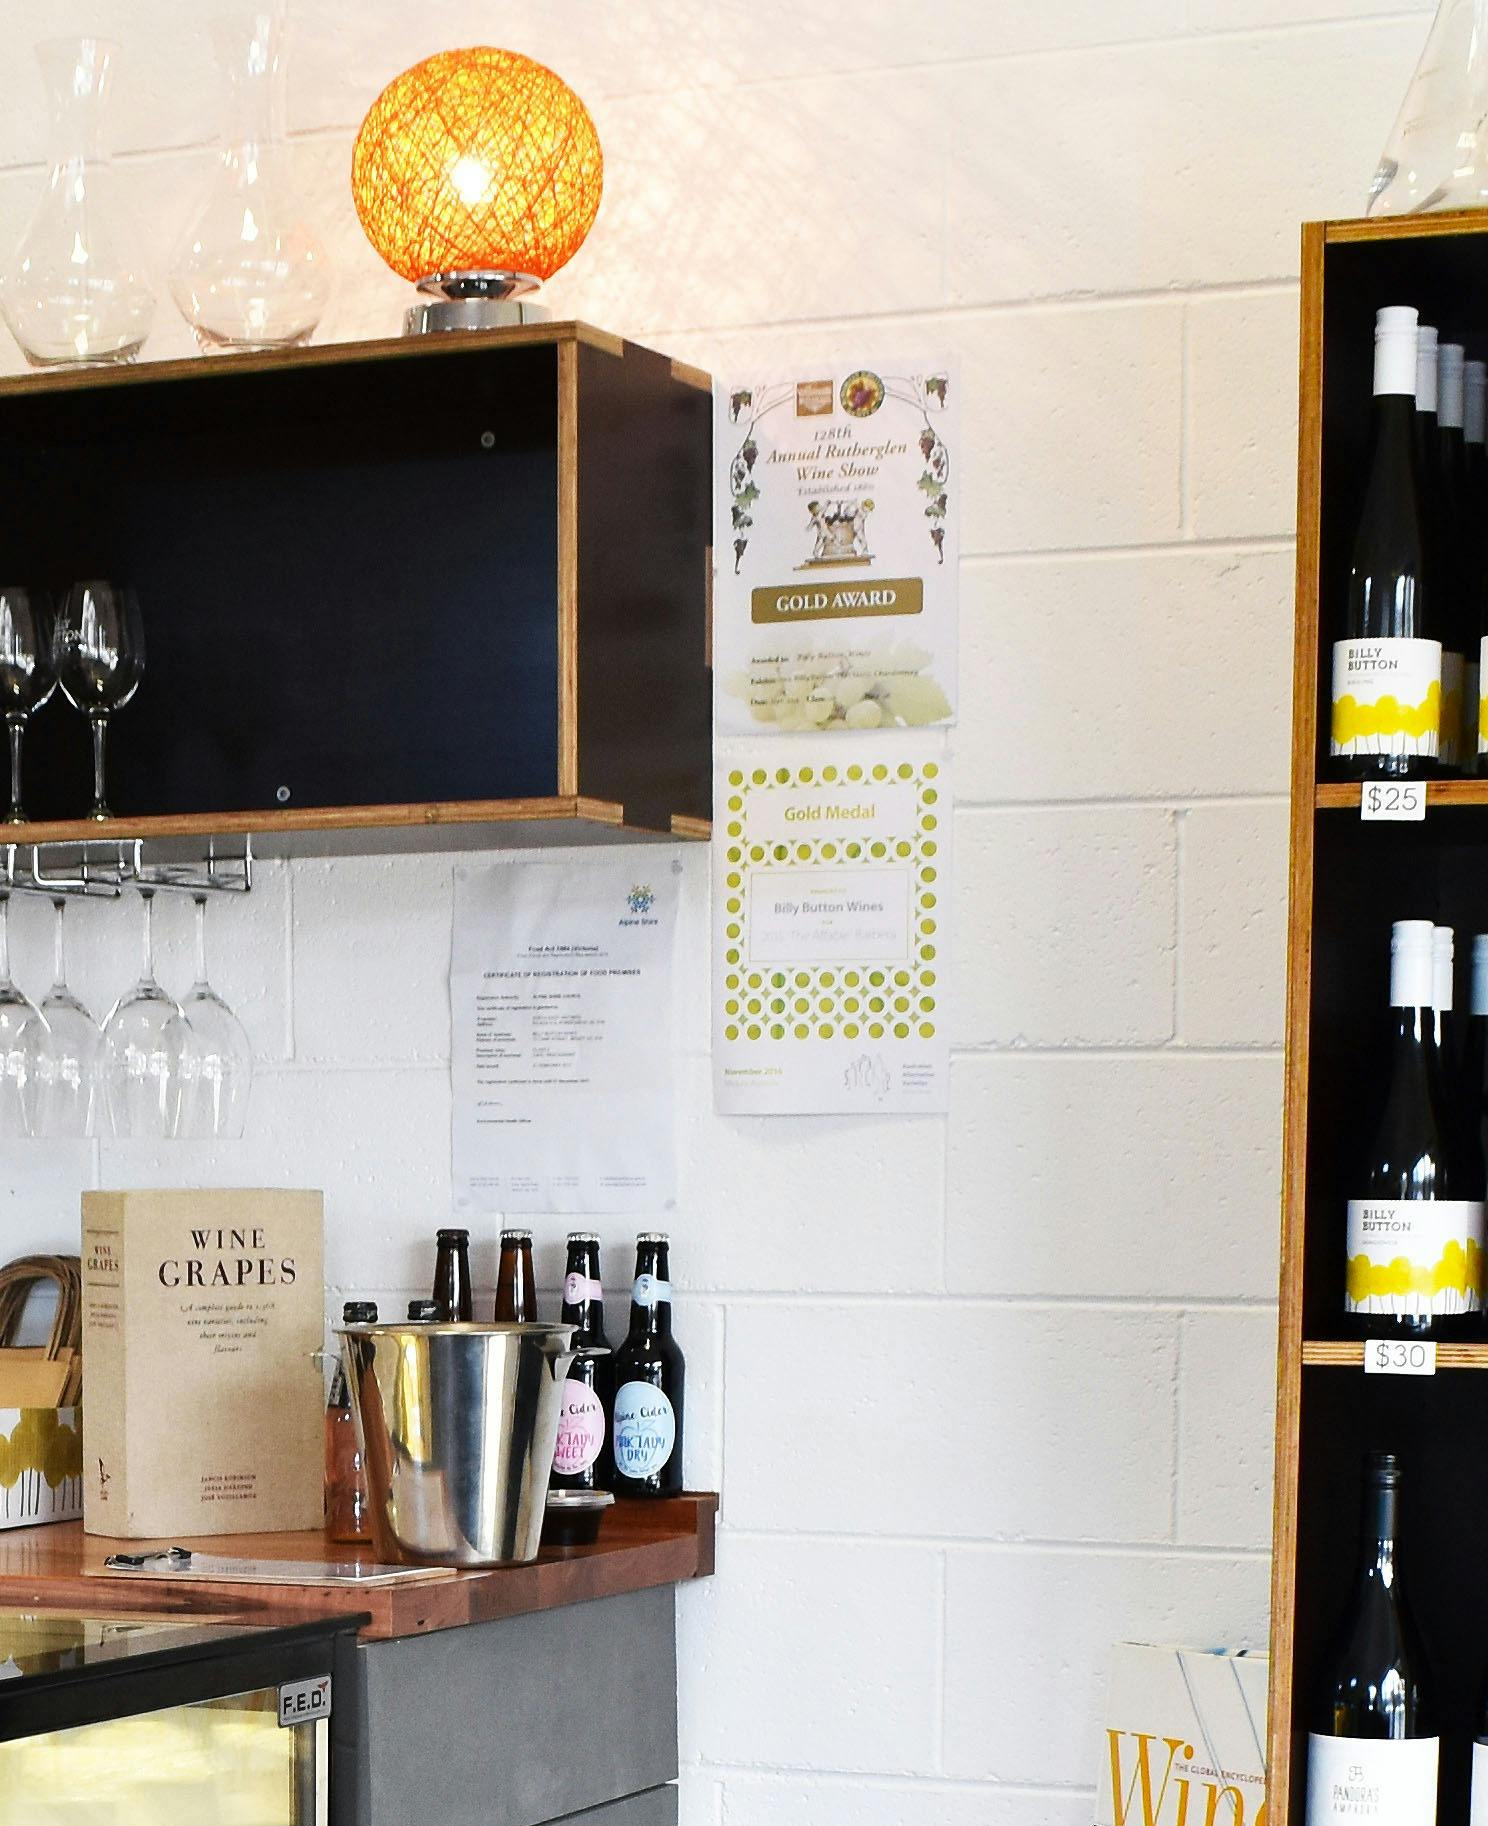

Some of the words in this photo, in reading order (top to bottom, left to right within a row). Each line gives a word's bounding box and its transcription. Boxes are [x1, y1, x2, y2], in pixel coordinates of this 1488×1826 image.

[767, 444, 822, 465] Annual
[825, 440, 908, 460] Rutherglen
[796, 466, 834, 480] Wine
[839, 462, 879, 478] Show
[776, 594, 828, 612] GOLD
[833, 589, 897, 608] AWARD
[1348, 659, 1398, 671] BUTTON
[1368, 784, 1419, 814] $25
[784, 806, 821, 822] Gold
[825, 803, 876, 820] Medal
[774, 902, 799, 916] Billy
[802, 902, 844, 914] Button
[847, 900, 884, 912] Wines
[1362, 1221, 1411, 1232] BUTTON
[190, 1228, 266, 1250] WINE
[93, 1245, 112, 1257] WINE
[87, 1255, 119, 1272] GRAPES
[157, 1258, 297, 1289] GRAPES
[1375, 1343, 1426, 1368] $30
[640, 1405, 668, 1418] Cider
[627, 1448, 648, 1462] DRY
[283, 1690, 327, 1715] F.E.D.
[1175, 1762, 1189, 1773] THE
[1190, 1765, 1218, 1778] GLOBAL
